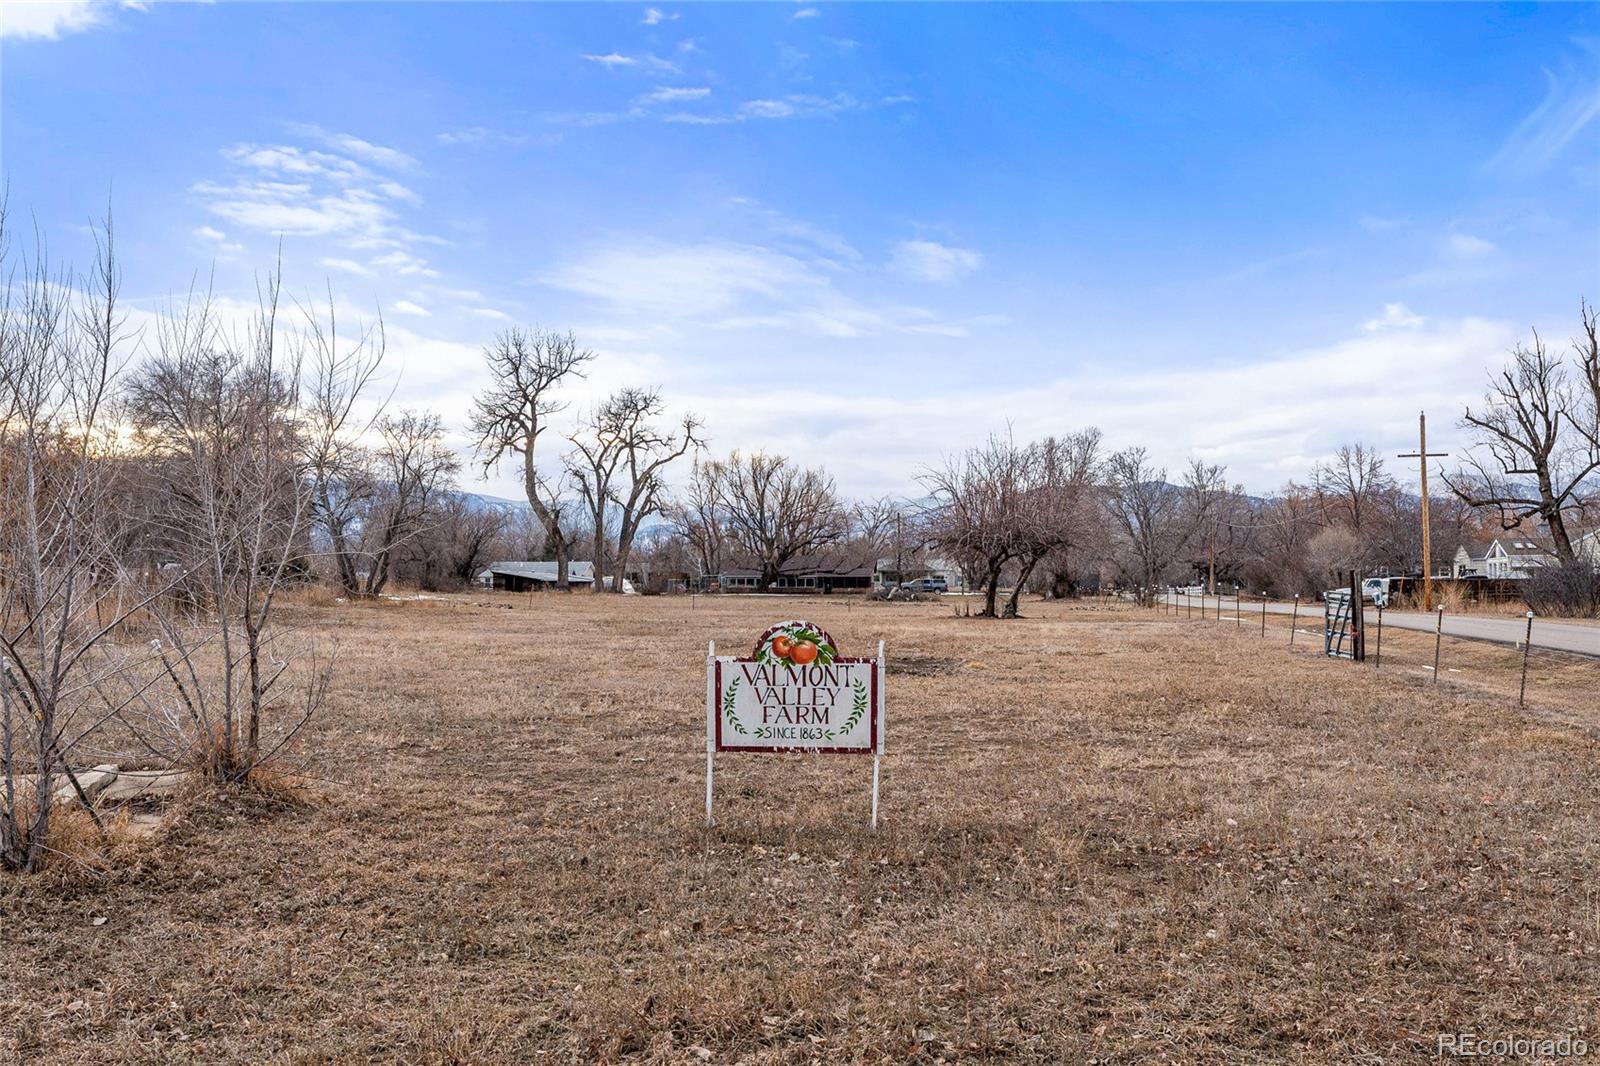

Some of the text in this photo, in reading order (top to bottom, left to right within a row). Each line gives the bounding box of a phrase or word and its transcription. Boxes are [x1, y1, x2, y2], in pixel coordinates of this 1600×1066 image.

[741, 664, 854, 687] VALMONT
[754, 687, 840, 706] VALLEY
[762, 706, 829, 724] FARM
[764, 726, 823, 740] SINCE 1863
